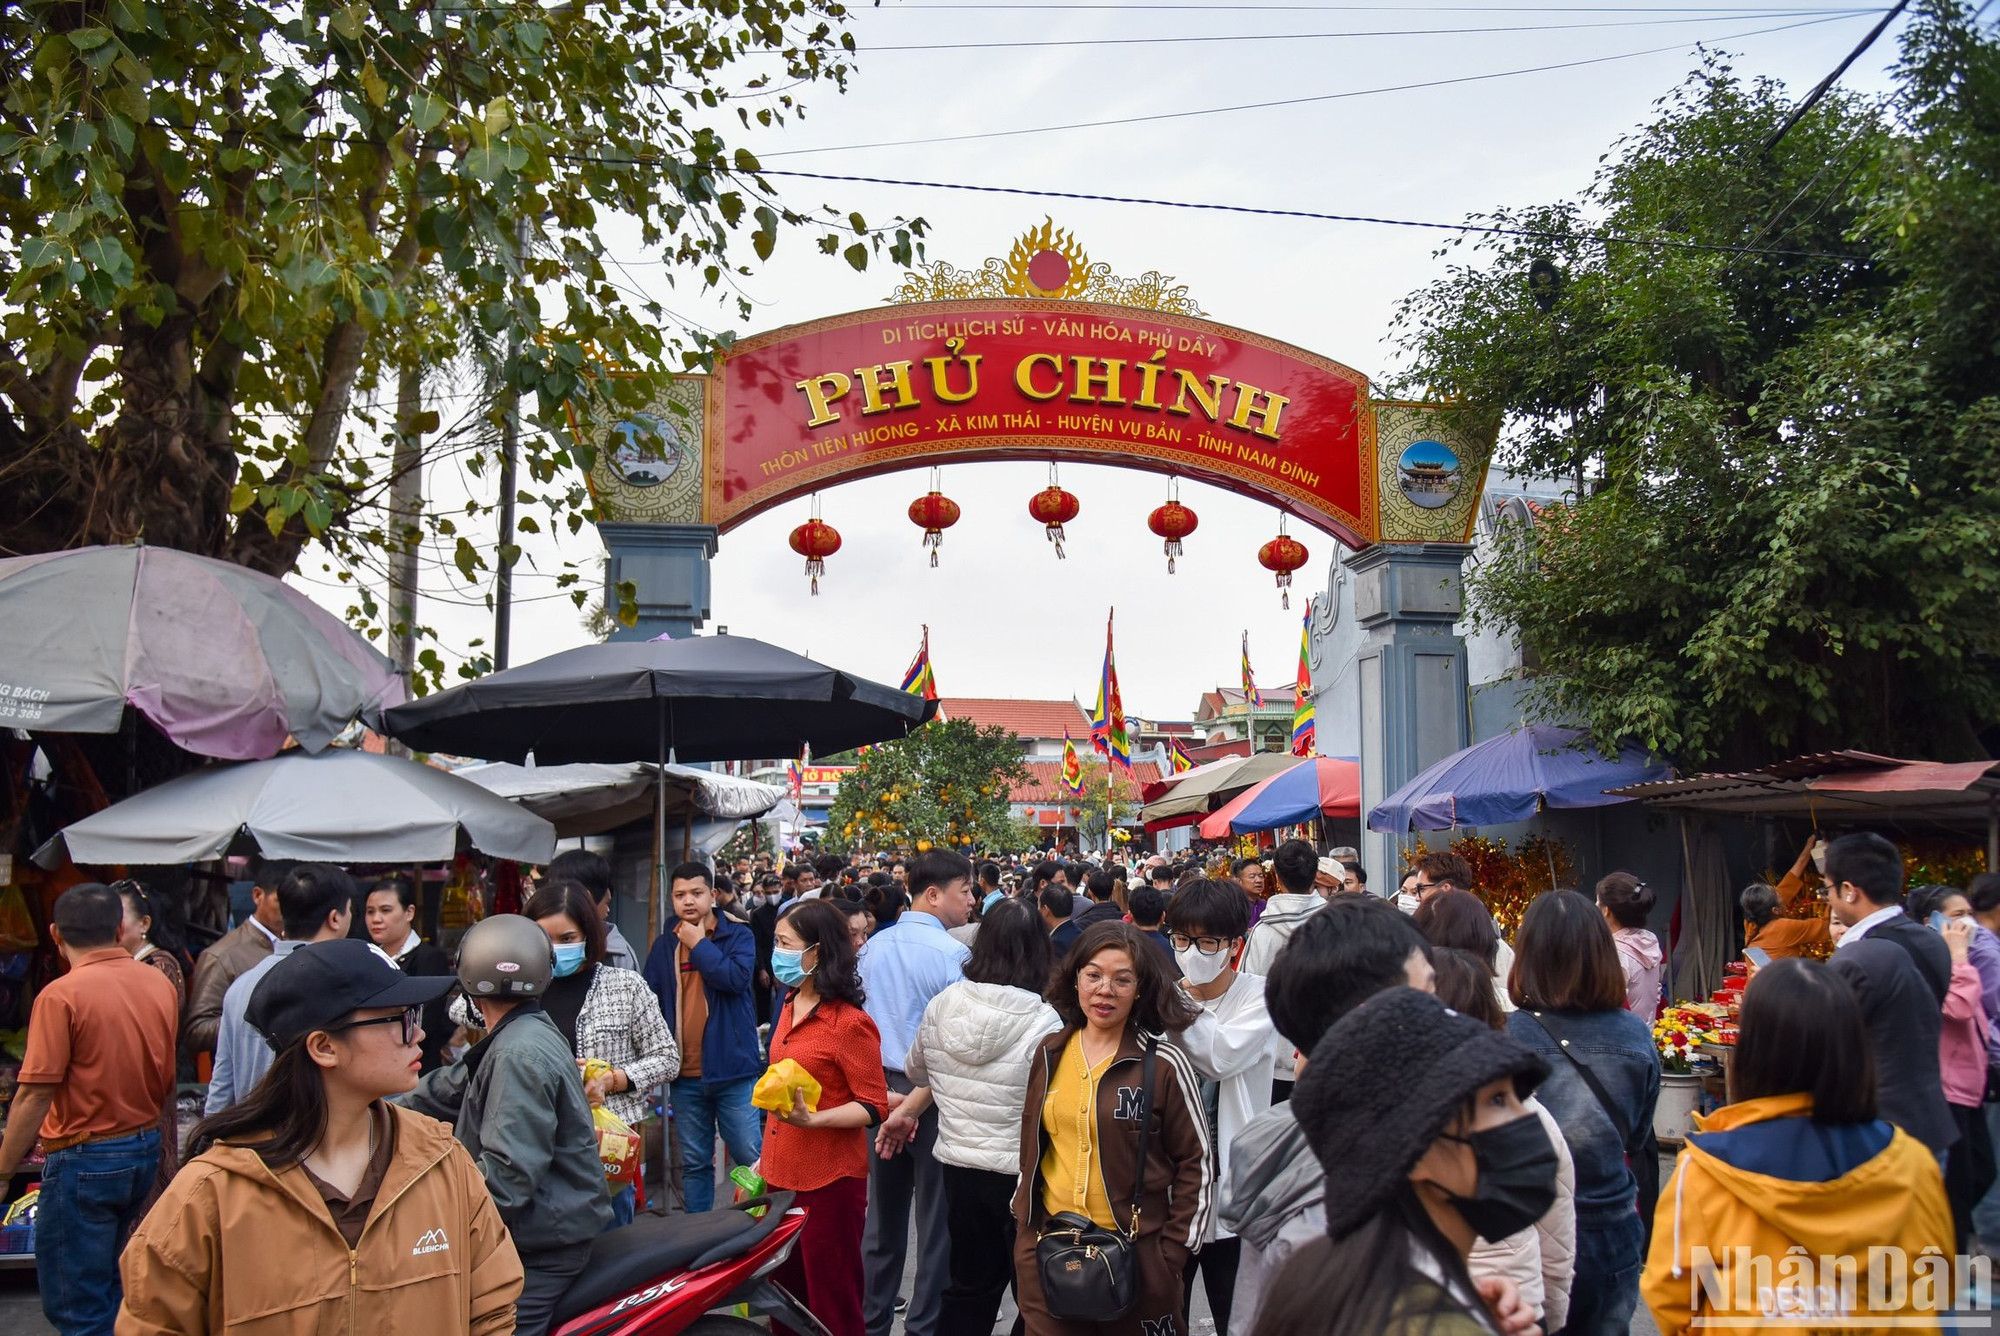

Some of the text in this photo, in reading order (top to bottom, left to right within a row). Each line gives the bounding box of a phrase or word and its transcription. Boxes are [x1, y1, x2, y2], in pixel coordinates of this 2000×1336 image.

[882, 328, 901, 345] DI
[906, 320, 949, 341] TÍCH
[955, 318, 996, 340] LỊCH
[1002, 313, 1025, 335] SỬ
[1043, 318, 1084, 338] VĂN
[1090, 320, 1133, 343] HÓA
[1138, 327, 1173, 349] PHỦ
[1178, 334, 1217, 358] DẦY
[795, 336, 1291, 442] PHỦ CHÍNH
[759, 448, 809, 477] THÔN
[811, 436, 848, 458] TIÊN
[852, 422, 919, 447] HƯƠNG
[936, 414, 962, 433] XÃ
[966, 414, 998, 430] KIM
[1002, 409, 1040, 429] THÁI
[1058, 413, 1113, 435] HUYỆN
[1119, 419, 1142, 437] VỤ
[1146, 421, 1181, 443] BẢN
[1198, 430, 1234, 456] TỈNH
[1236, 445, 1277, 471] NAM
[1279, 460, 1320, 488] ĐỊNH
[12, 686, 51, 701] BÁCH
[1114, 1086, 1144, 1121] M
[1141, 1314, 1176, 1336] M
